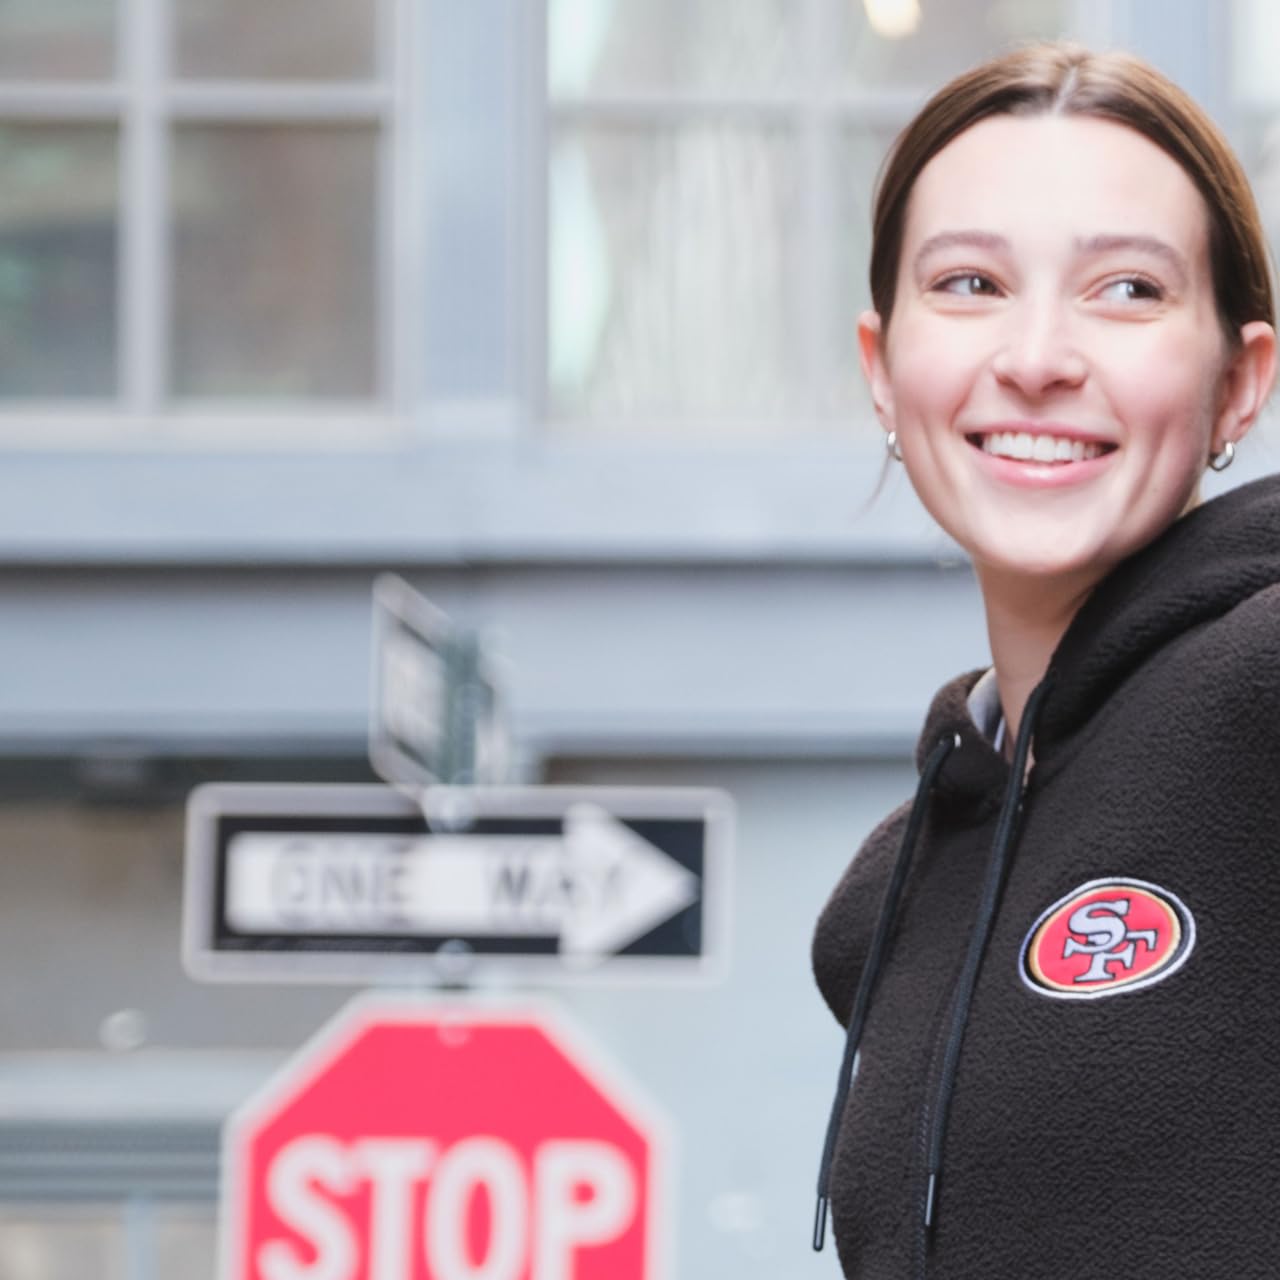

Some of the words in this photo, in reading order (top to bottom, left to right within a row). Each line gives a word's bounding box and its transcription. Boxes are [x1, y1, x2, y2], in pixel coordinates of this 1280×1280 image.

[274, 840, 414, 928] ONE
[484, 840, 630, 928] WAY
[1062, 898, 1158, 983] SF
